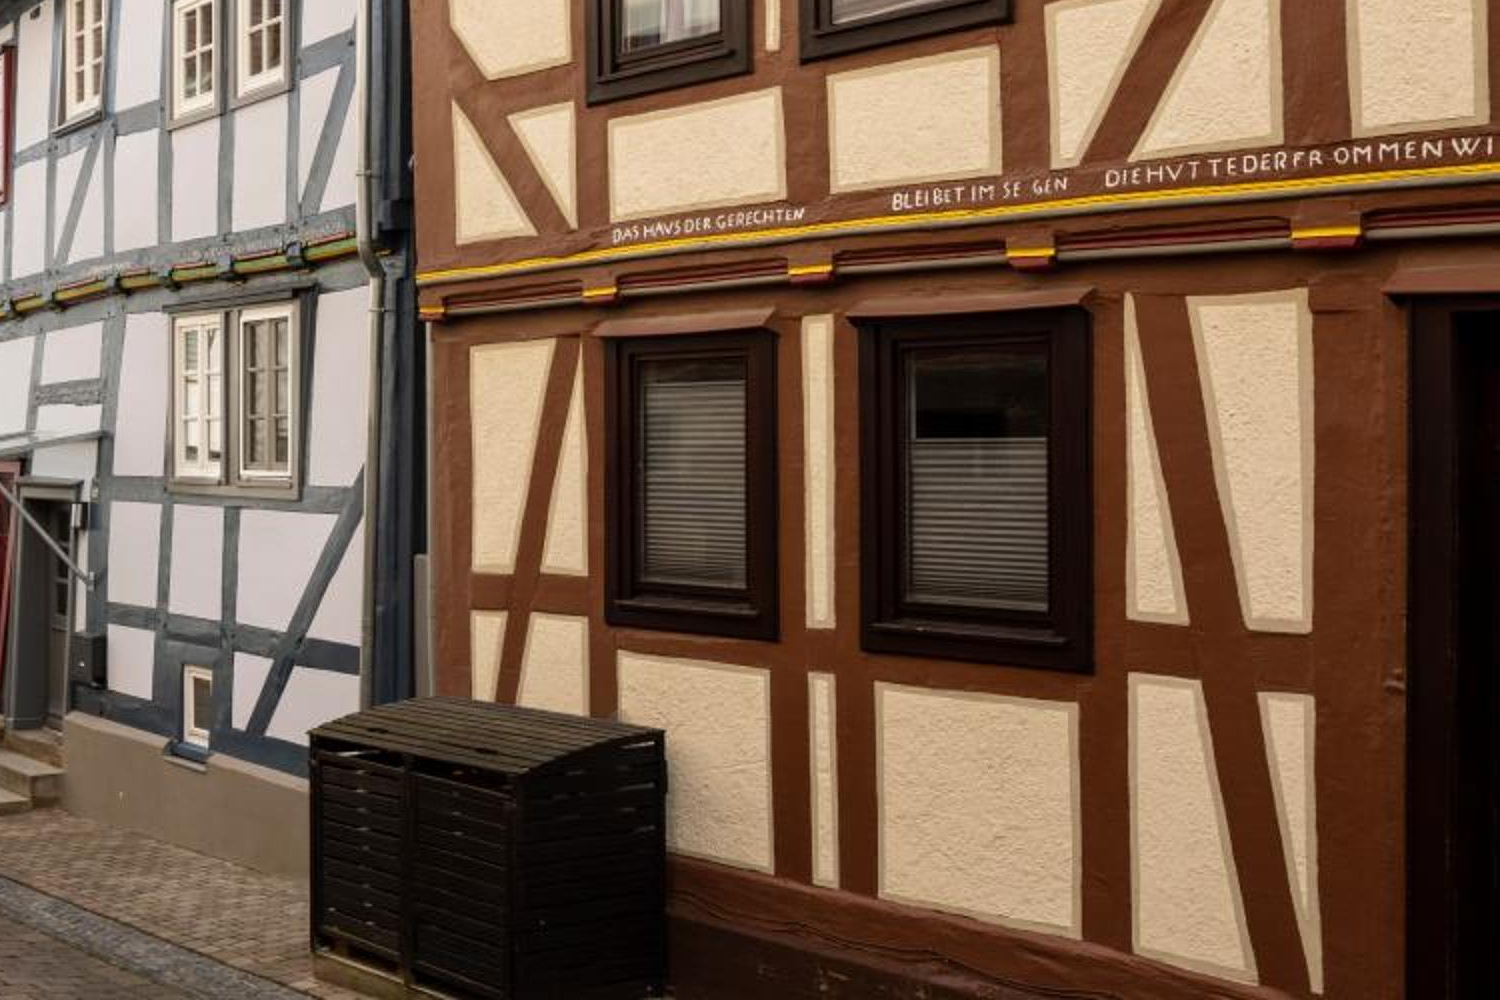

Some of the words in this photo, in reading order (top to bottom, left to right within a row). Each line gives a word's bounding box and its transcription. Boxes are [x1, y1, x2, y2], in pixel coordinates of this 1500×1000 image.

[612, 225, 639, 244] DAS
[684, 217, 711, 233] DER
[715, 208, 805, 229] GERECHTEN
[892, 186, 965, 211] BLEIBET
[972, 185, 995, 202] IM
